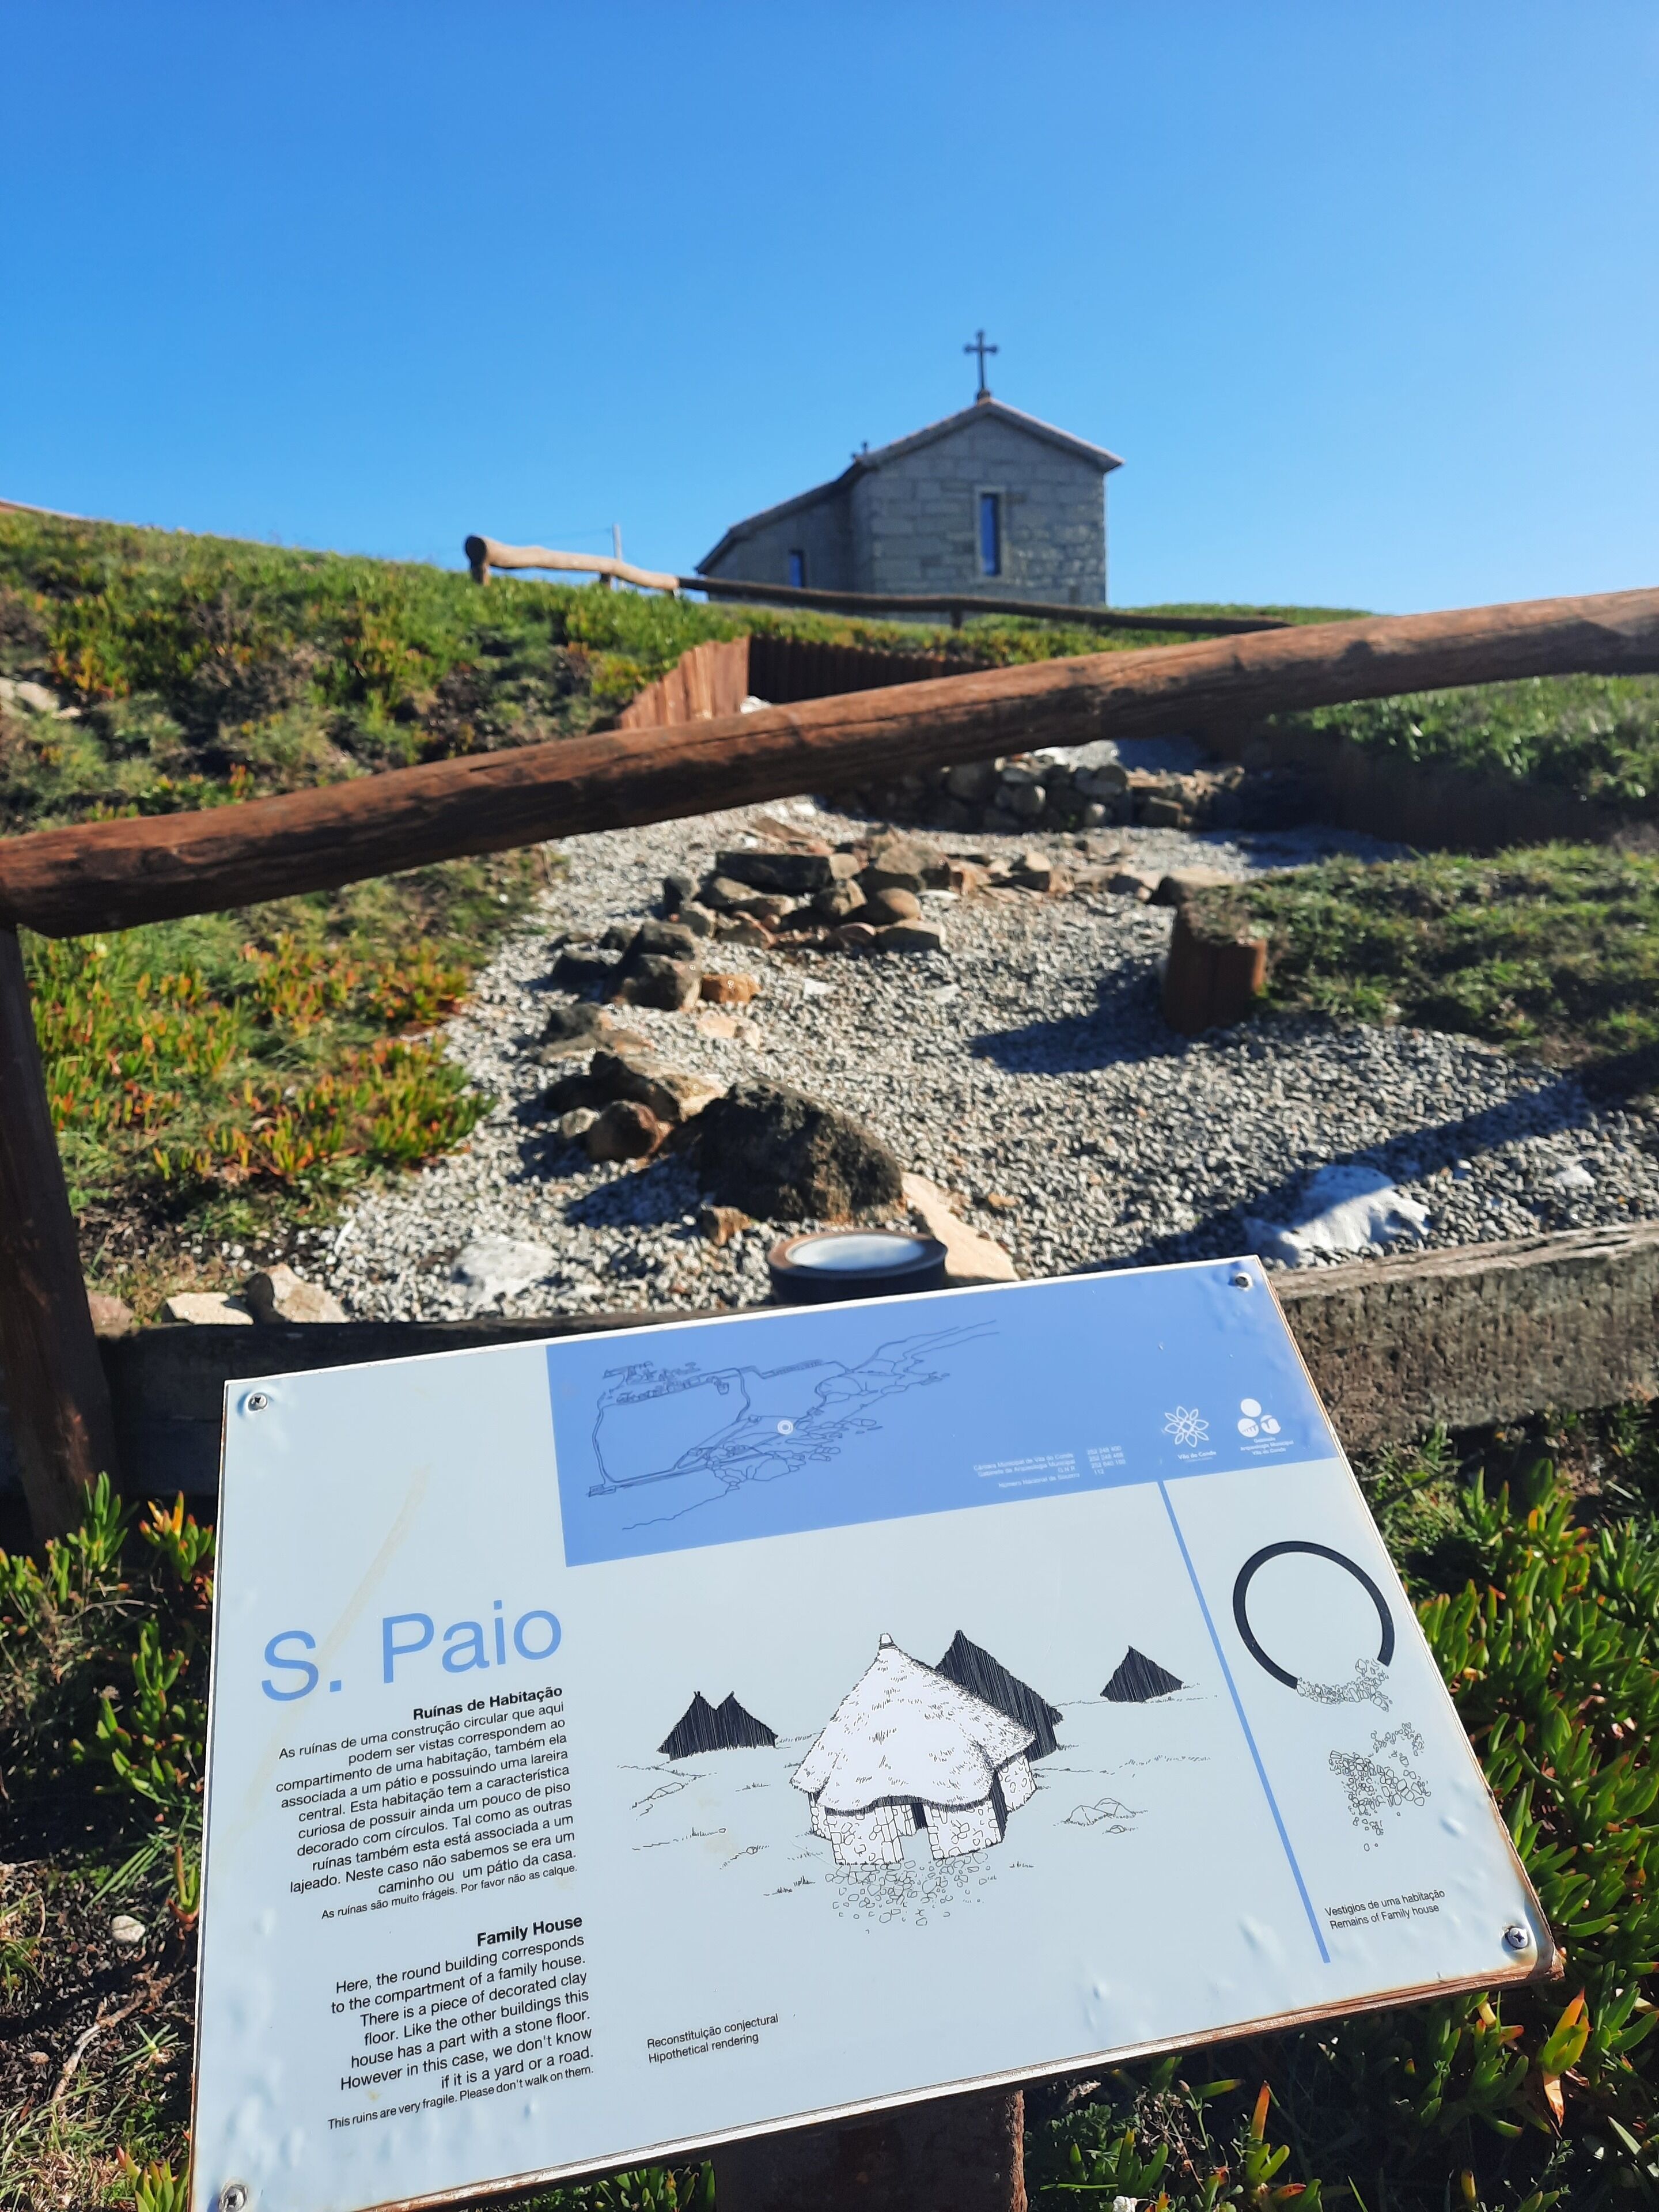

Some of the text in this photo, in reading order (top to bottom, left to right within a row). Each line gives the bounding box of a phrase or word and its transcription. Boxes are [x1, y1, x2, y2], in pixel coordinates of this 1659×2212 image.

[262, 1600, 562, 1701] S. Paio
[279, 1701, 563, 1760] As ruínas de uma construção circular que aqui
[413, 1686, 562, 1721] Ruínas de Habitação
[276, 1733, 567, 1792] compartimento de uma habitação, também ela
[349, 1719, 565, 1766] podem ser vistas correspondem ao
[281, 1750, 569, 1808] associada a um pátio e possuindo uma lareira
[298, 1766, 570, 1822] central. Esta habitação tem a característica
[297, 1799, 572, 1857] decorado com círculos. Tal como as outras
[298, 1782, 571, 1839] curiosa de possuir ainda um pouco de piso
[290, 1832, 575, 1894] lajeado. Neste caso não sabemos se era um
[313, 1816, 573, 1871] ruínas também esta está associada a um
[321, 1865, 577, 1919] As ruínas são muito frágeis. Por favor não as calque.
[378, 1850, 576, 1894] caminho ou um pátio da casa.
[1368, 1900, 1380, 1910] de
[1381, 1897, 1402, 1907] uma
[1401, 1889, 1445, 1904] habitação
[477, 1917, 582, 1947] Family House
[1329, 1905, 1440, 1930] Remains of Family house
[331, 1955, 585, 2014] to the compartment of a family house.
[336, 1934, 584, 1994] Here, the round building corresponds
[360, 1972, 587, 2027] There is a piece of decorated clay
[364, 1991, 589, 2046] floor. Like the other buildings this
[351, 2010, 590, 2069] house has a part with a stone floor.
[647, 2013, 778, 2049] Reconstituição conjectural
[649, 2034, 759, 2064] Hipothetical rendering
[341, 2028, 592, 2090] However in this case, we don't know
[441, 2046, 593, 2089] if it is a yard or a road.
[327, 2066, 593, 2130] This ruins are very fragile. Please don't walk on them.
